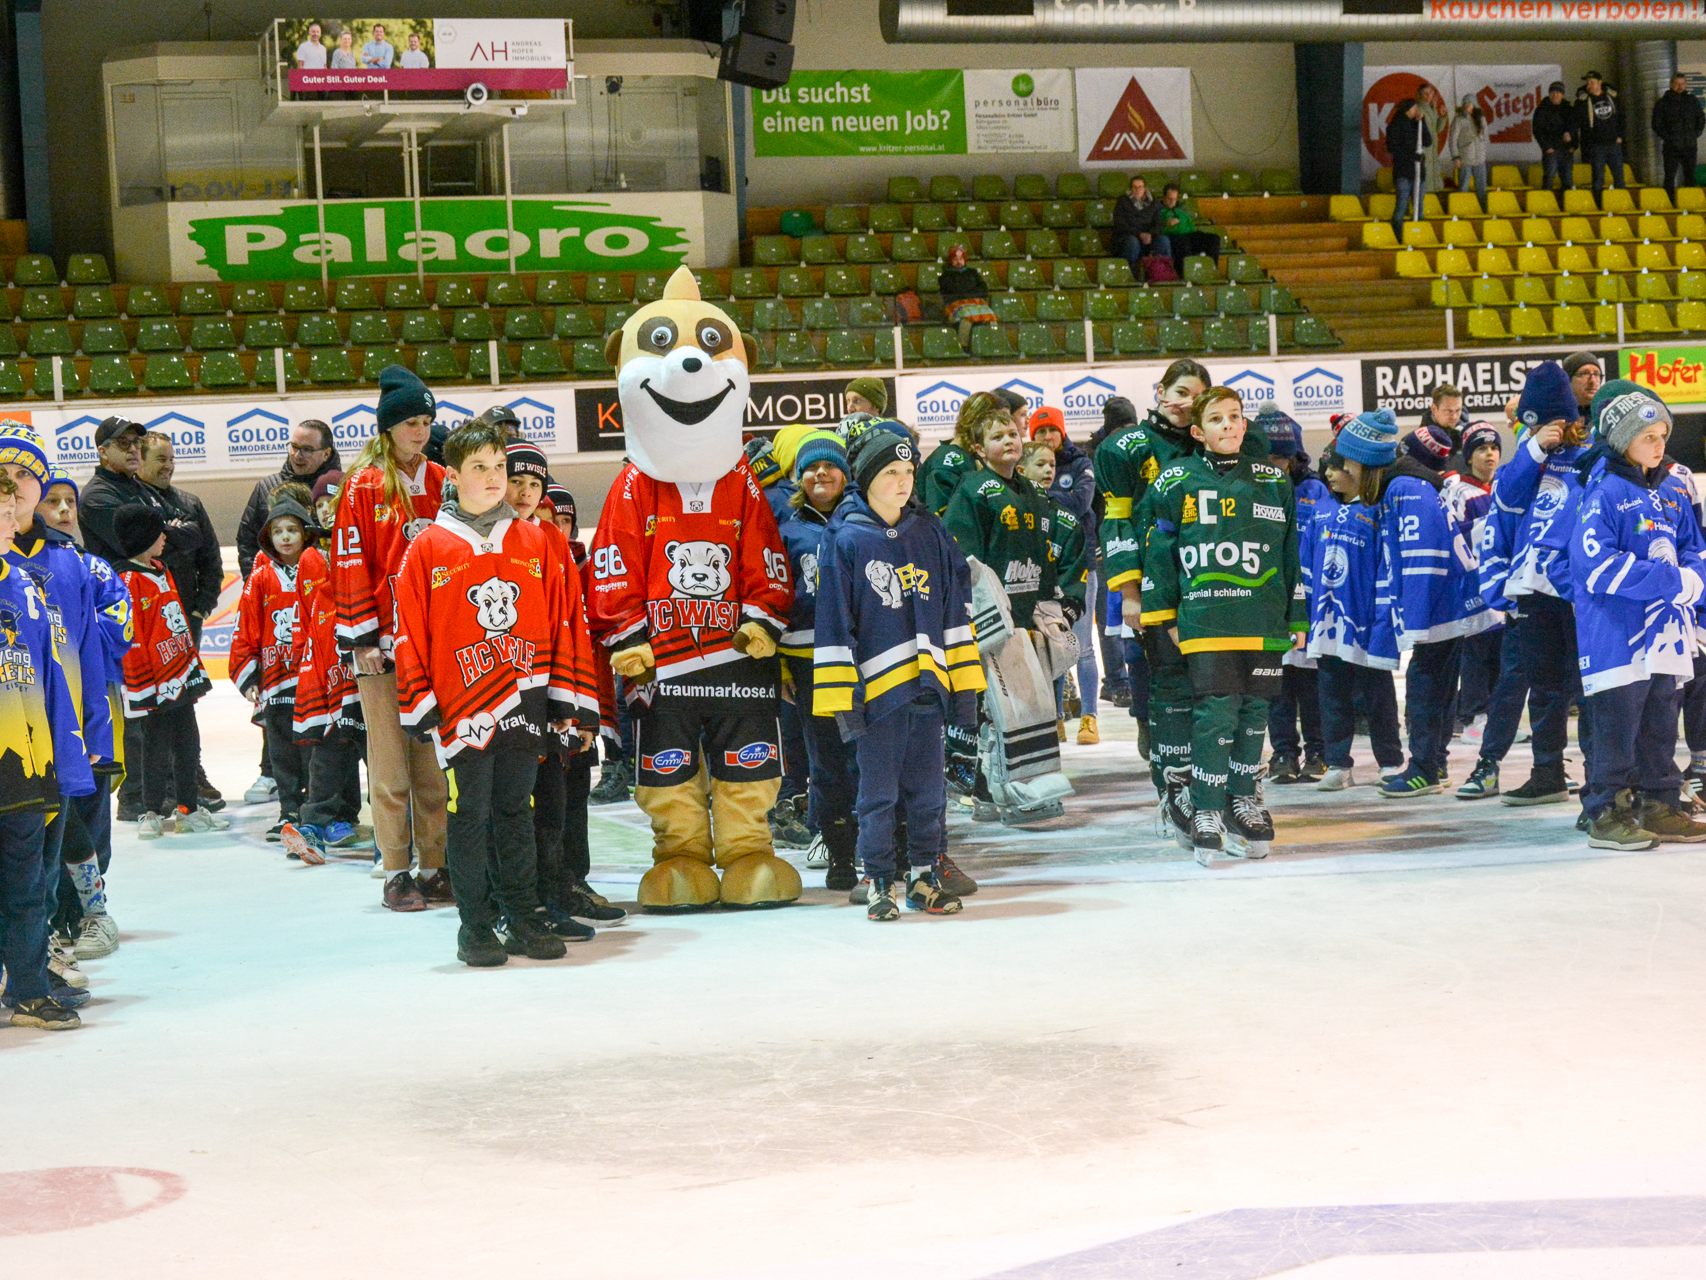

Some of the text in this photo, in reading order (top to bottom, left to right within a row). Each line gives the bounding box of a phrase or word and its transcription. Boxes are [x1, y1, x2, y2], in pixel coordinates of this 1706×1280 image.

[302, 74, 388, 84] Guter Stil. Guter Deal.
[798, 81, 872, 103] suchst
[763, 109, 951, 135] einen neuen Job?
[224, 207, 650, 265] Palaoro
[1629, 353, 1703, 387] Hofer
[1236, 388, 1275, 400] OLOB
[1294, 385, 1344, 399] GOLOB
[917, 399, 961, 413] GOLO
[523, 416, 555, 430] LOB
[171, 431, 206, 445] LOB
[228, 428, 290, 443] GOLOB
[57, 436, 95, 451] GOL
[229, 444, 284, 453] IMMODREAM
[514, 461, 547, 478] HC WISLE
[1219, 498, 1236, 517] 12
[1582, 527, 1601, 558] 6
[1213, 588, 1252, 597] schlafen
[456, 641, 495, 688] HC
[655, 755, 684, 767] Emmi
[740, 750, 769, 761] Emmi
